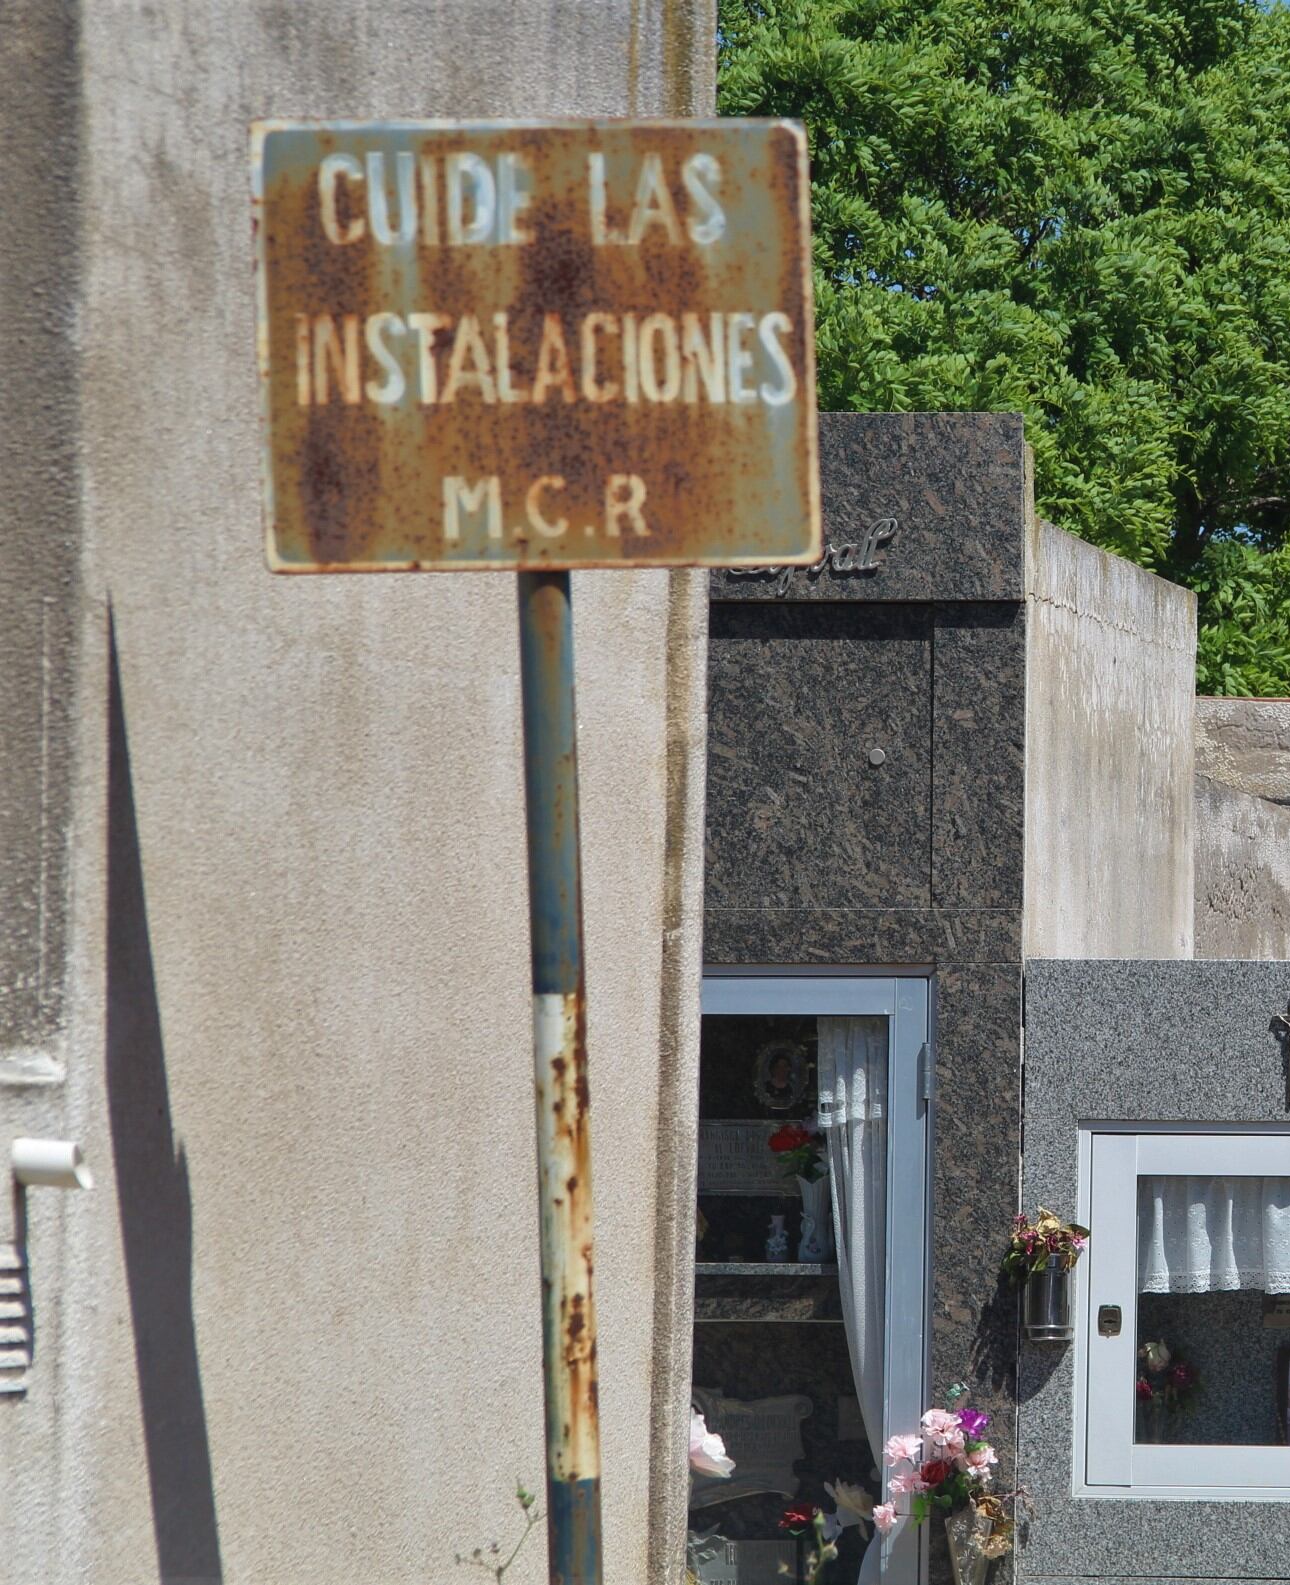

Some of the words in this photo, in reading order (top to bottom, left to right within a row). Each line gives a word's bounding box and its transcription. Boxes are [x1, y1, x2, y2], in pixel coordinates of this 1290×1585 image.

[318, 151, 536, 246] CUIDE
[587, 152, 728, 246] LAS
[295, 310, 798, 406] INSTALACIONES
